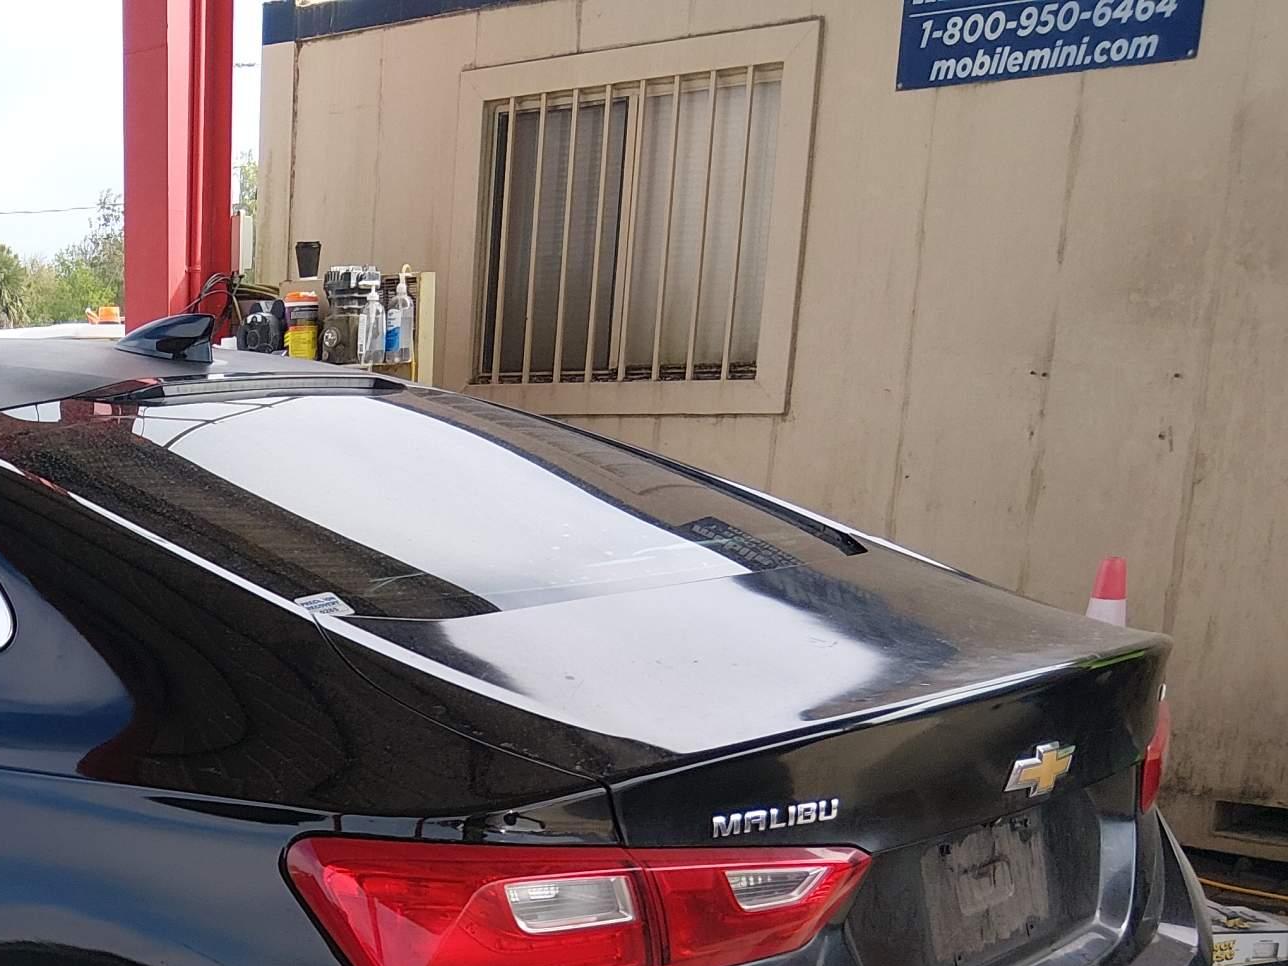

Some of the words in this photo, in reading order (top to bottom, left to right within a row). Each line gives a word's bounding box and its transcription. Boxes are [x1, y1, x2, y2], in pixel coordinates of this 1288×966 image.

[920, 0, 1178, 48] 1-800-950-6464
[929, 34, 1159, 81] mobilemini.com
[712, 798, 839, 839] MALIBU
